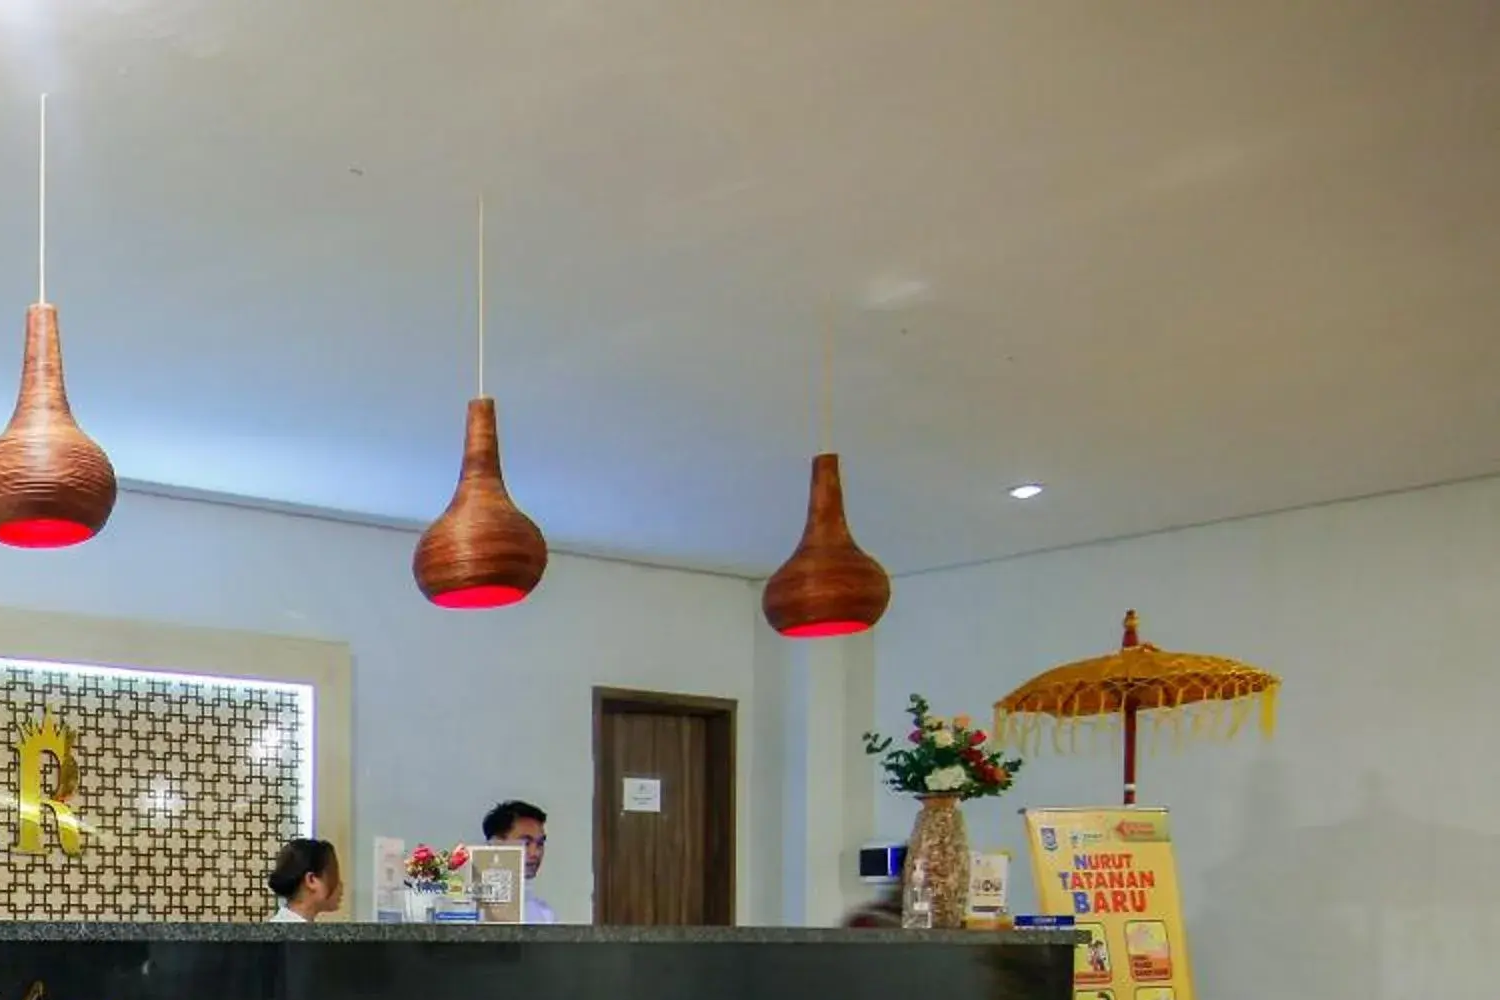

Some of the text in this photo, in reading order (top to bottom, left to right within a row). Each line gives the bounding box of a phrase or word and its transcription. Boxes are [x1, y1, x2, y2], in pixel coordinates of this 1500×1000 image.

[10, 703, 85, 857] R
[1073, 854, 1133, 870] NURUT
[1058, 870, 1155, 890] TATANAN
[1073, 890, 1147, 913] BARU
